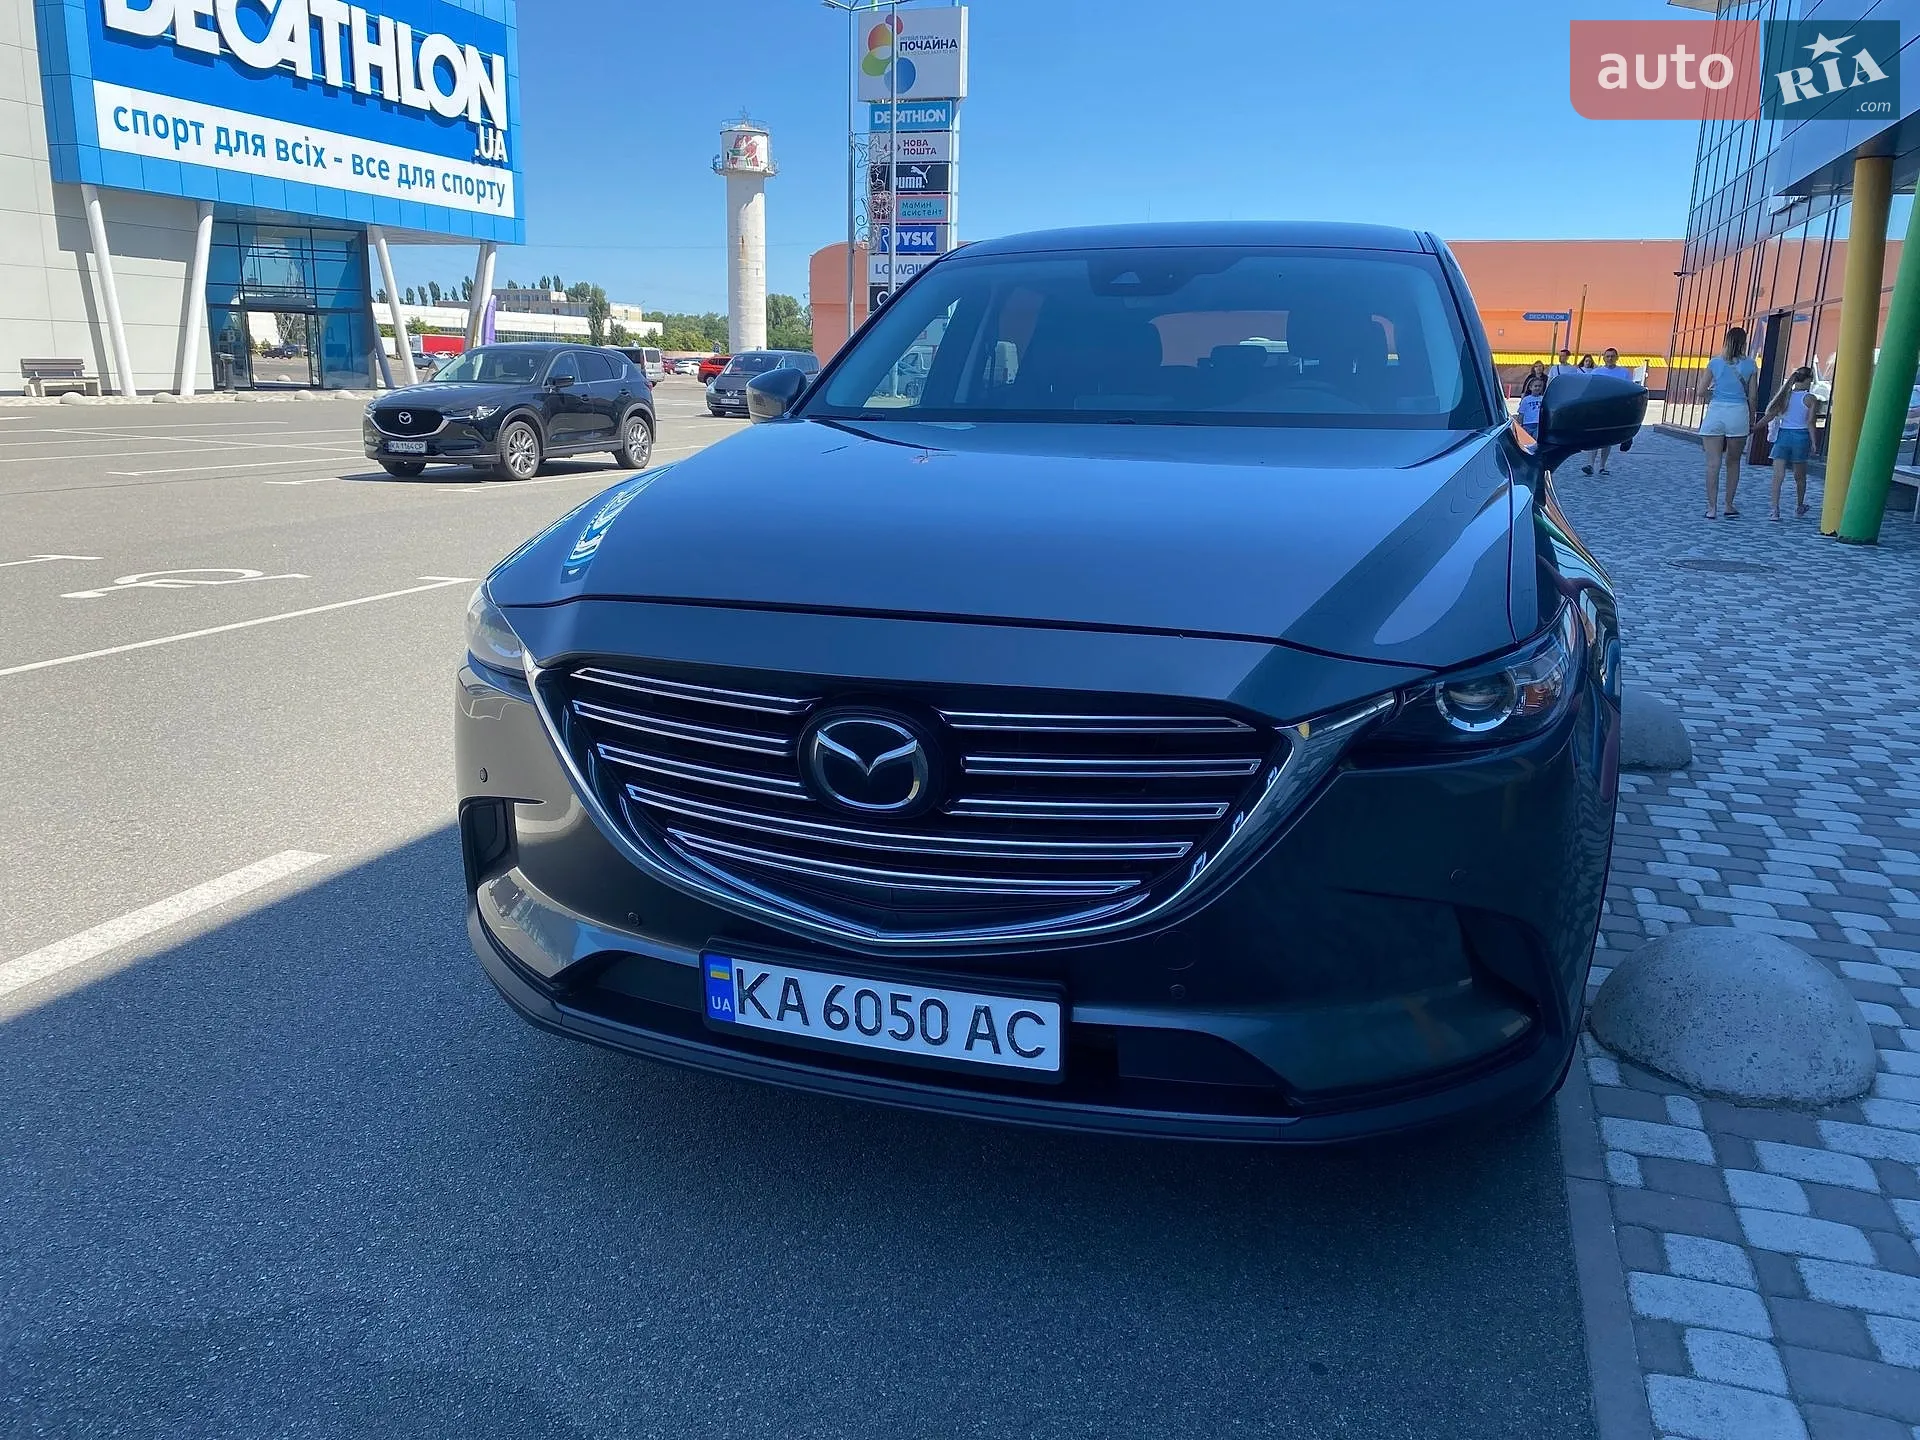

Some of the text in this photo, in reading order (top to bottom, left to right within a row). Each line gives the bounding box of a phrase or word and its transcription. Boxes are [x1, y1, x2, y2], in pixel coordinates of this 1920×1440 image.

[900, 36, 958, 51] ПОЧАЙНА
[874, 109, 946, 124] DEATHLON
[474, 125, 509, 162] .UA
[903, 139, 929, 147] НОВА
[113, 106, 205, 151] спорт
[214, 125, 267, 157] для
[275, 135, 327, 169] всіх
[351, 153, 390, 181] все
[397, 163, 435, 189] для
[441, 172, 506, 208] спорту
[903, 147, 937, 156] ПОШТА
[712, 995, 732, 1013] UA
[735, 968, 1046, 1058] KA 6050 AC
